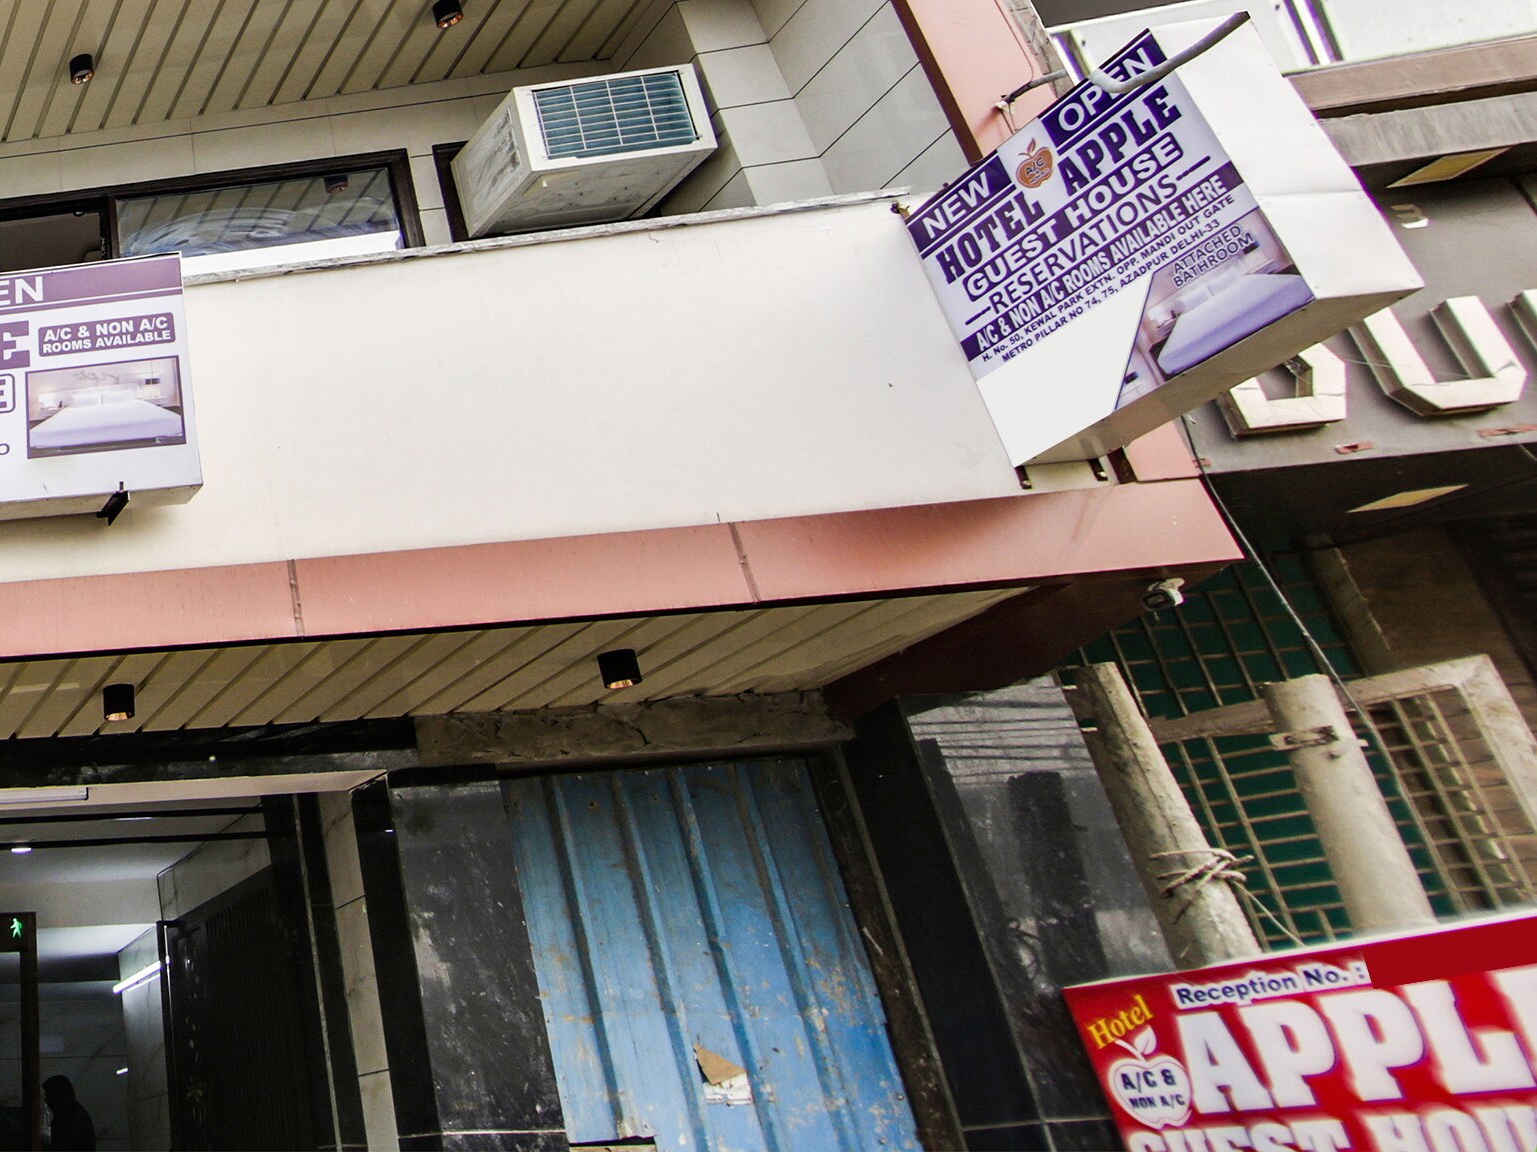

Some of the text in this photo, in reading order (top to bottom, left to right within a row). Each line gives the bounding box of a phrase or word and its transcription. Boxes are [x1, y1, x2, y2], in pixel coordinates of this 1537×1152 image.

[922, 172, 992, 239] NEW
[935, 85, 1182, 284] HOTEL APPLE
[966, 136, 1181, 298] GUEST HOUSE
[989, 174, 1178, 315] RESERVATIONS
[976, 174, 1228, 352] A/C & NON A/C ROOMS AVAILABLE HERE
[1024, 312, 1056, 336] KEWAL
[1058, 292, 1083, 313] PARK
[1085, 275, 1116, 296] EXTN.
[1116, 258, 1140, 274] OPP.
[1141, 234, 1176, 259] MANDI
[1179, 216, 1201, 236] OUT
[1203, 195, 1235, 218] GATE
[1173, 225, 1242, 274] ATTACHED
[1173, 232, 1255, 288] BATHROOM
[1001, 338, 1033, 362] METRO
[1035, 317, 1067, 341] PILLAR
[1069, 305, 1083, 319] NO
[1120, 252, 1170, 287] AZADPUR
[1172, 220, 1220, 255] DELHI-33
[42, 330, 172, 354] ROOMS AVAILABLE
[44, 316, 168, 342] A/C & NON A/C
[1176, 973, 1298, 1005] Reception
[1300, 967, 1348, 986] No.
[1087, 994, 1154, 1049] Hotel
[1121, 1068, 1177, 1093] A/C &
[1128, 1094, 1186, 1110] NON A/C
